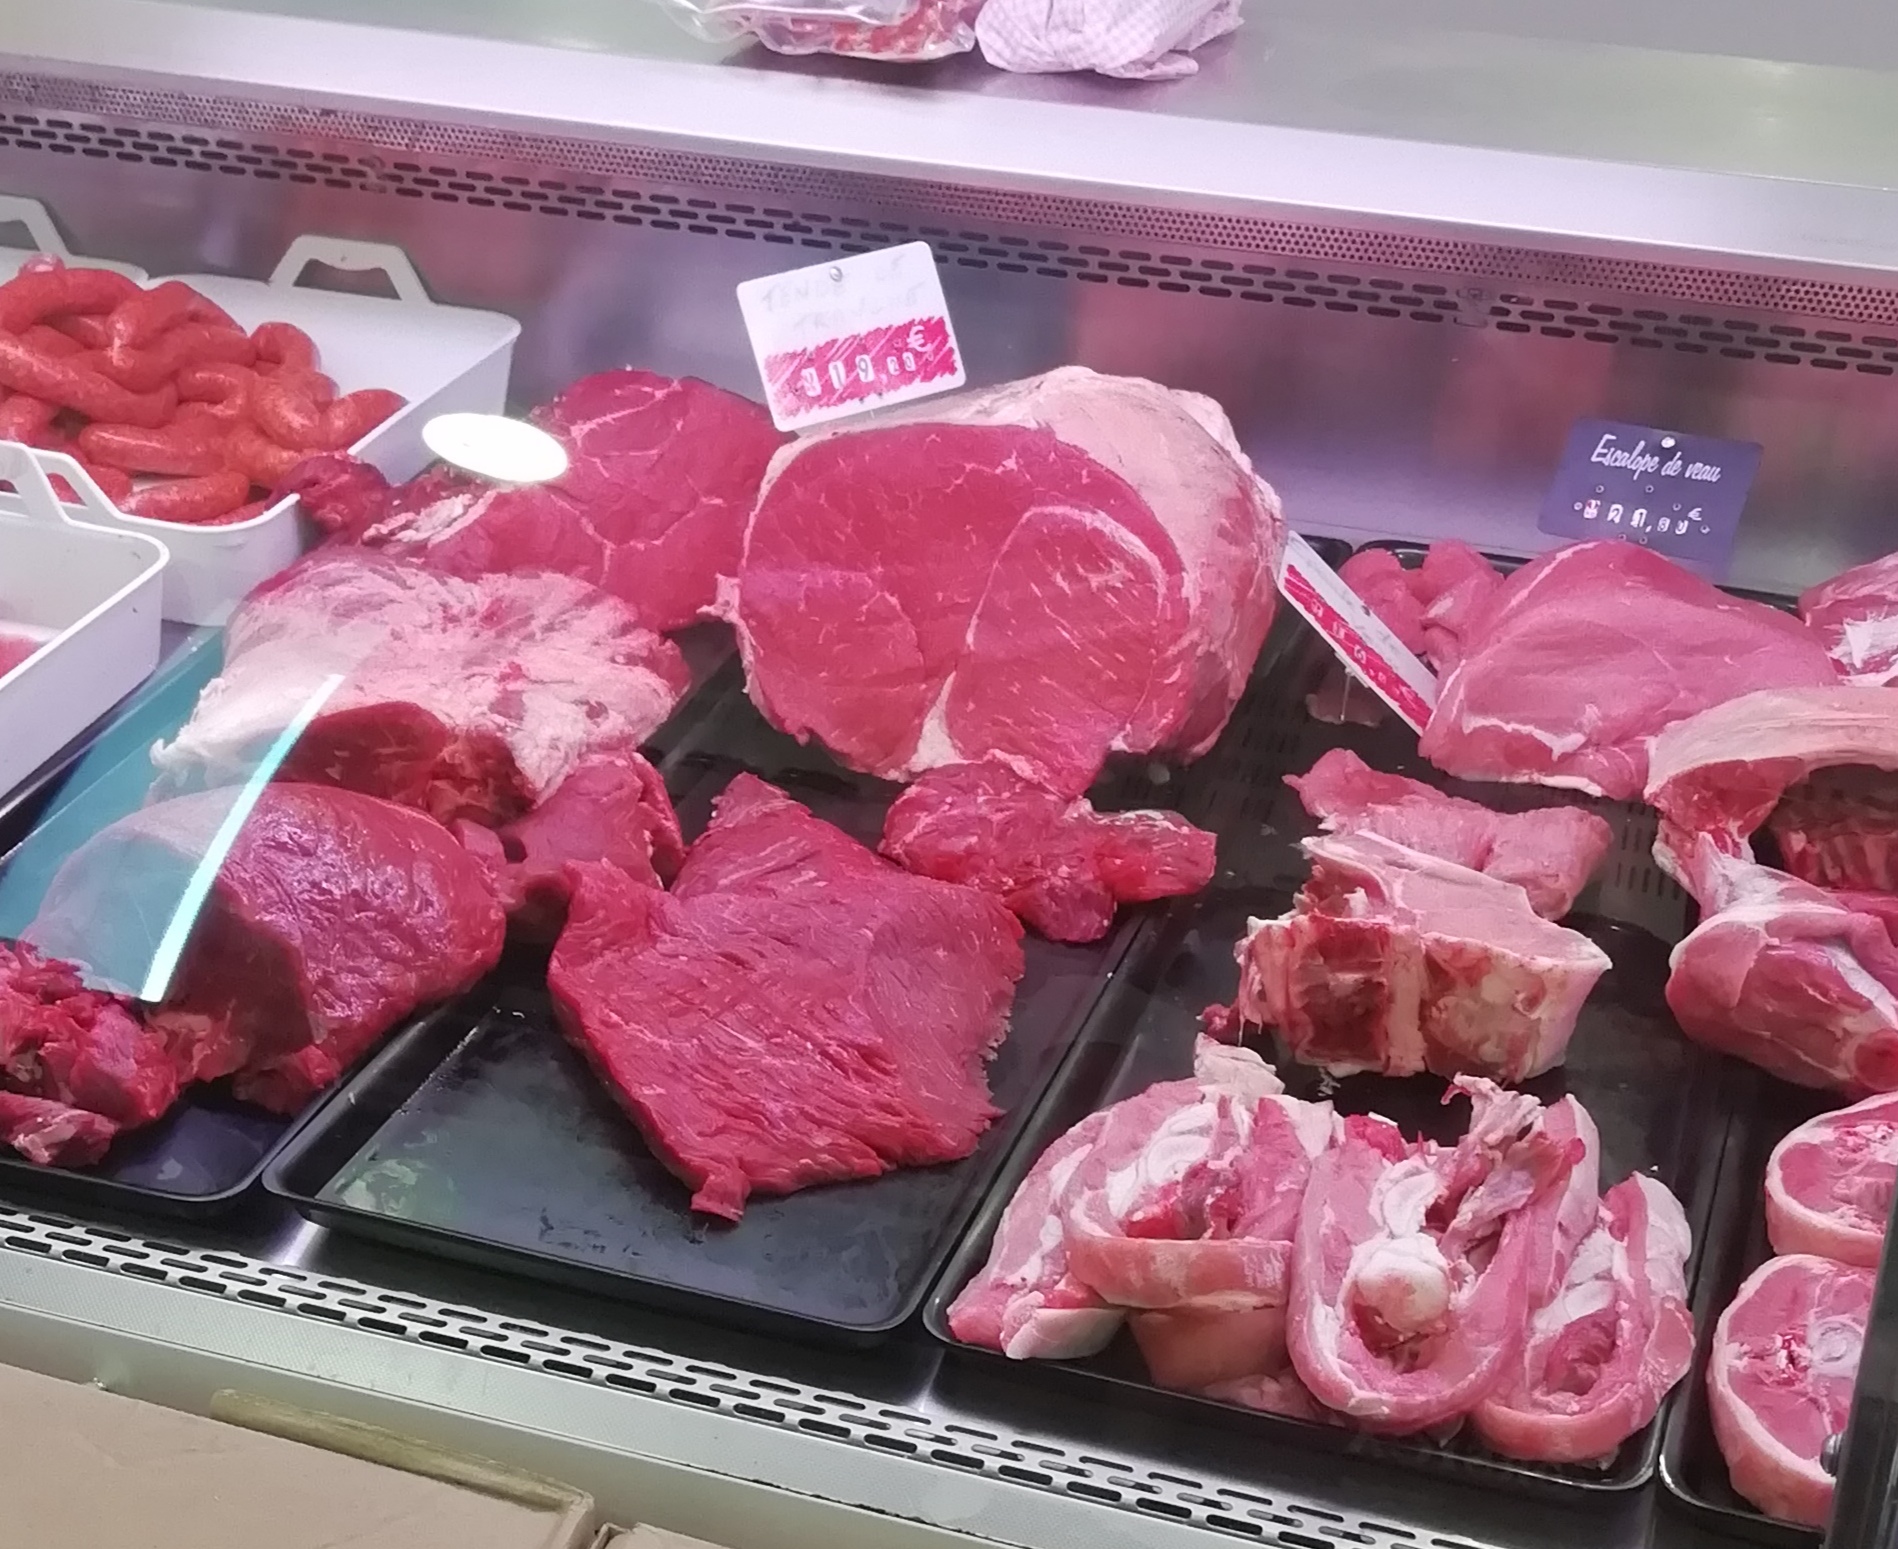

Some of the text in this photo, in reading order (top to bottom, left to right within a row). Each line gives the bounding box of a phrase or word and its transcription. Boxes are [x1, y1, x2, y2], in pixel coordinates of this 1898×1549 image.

[1591, 433, 1722, 483] Escalope de veau
